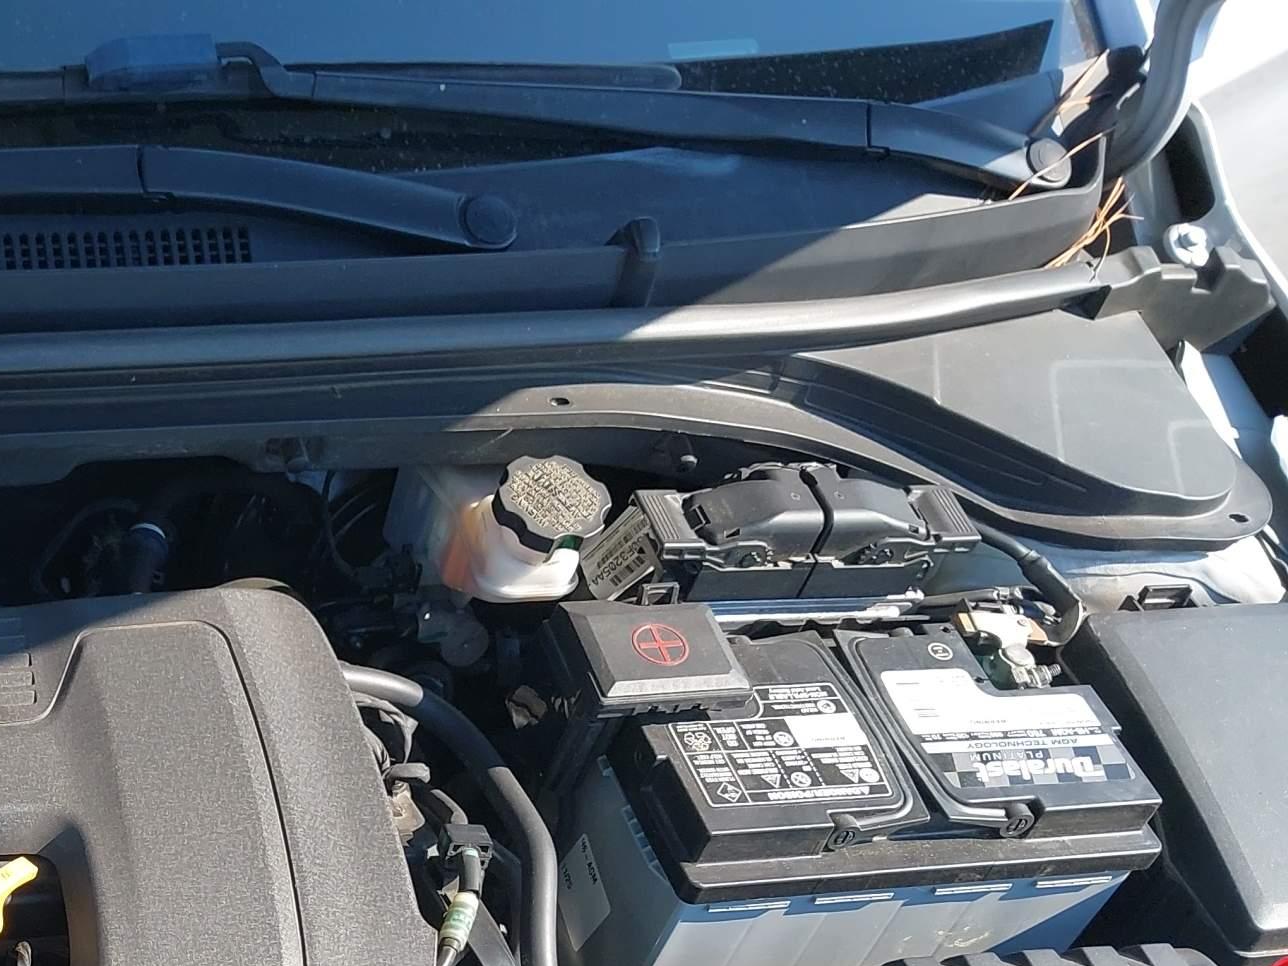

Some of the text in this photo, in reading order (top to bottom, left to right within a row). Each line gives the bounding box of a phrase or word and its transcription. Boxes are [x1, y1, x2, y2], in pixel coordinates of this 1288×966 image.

[966, 738, 1078, 750] AGM TECHNOLOGY
[969, 749, 1044, 762] PLATINUM
[972, 756, 1105, 783] Duralast
